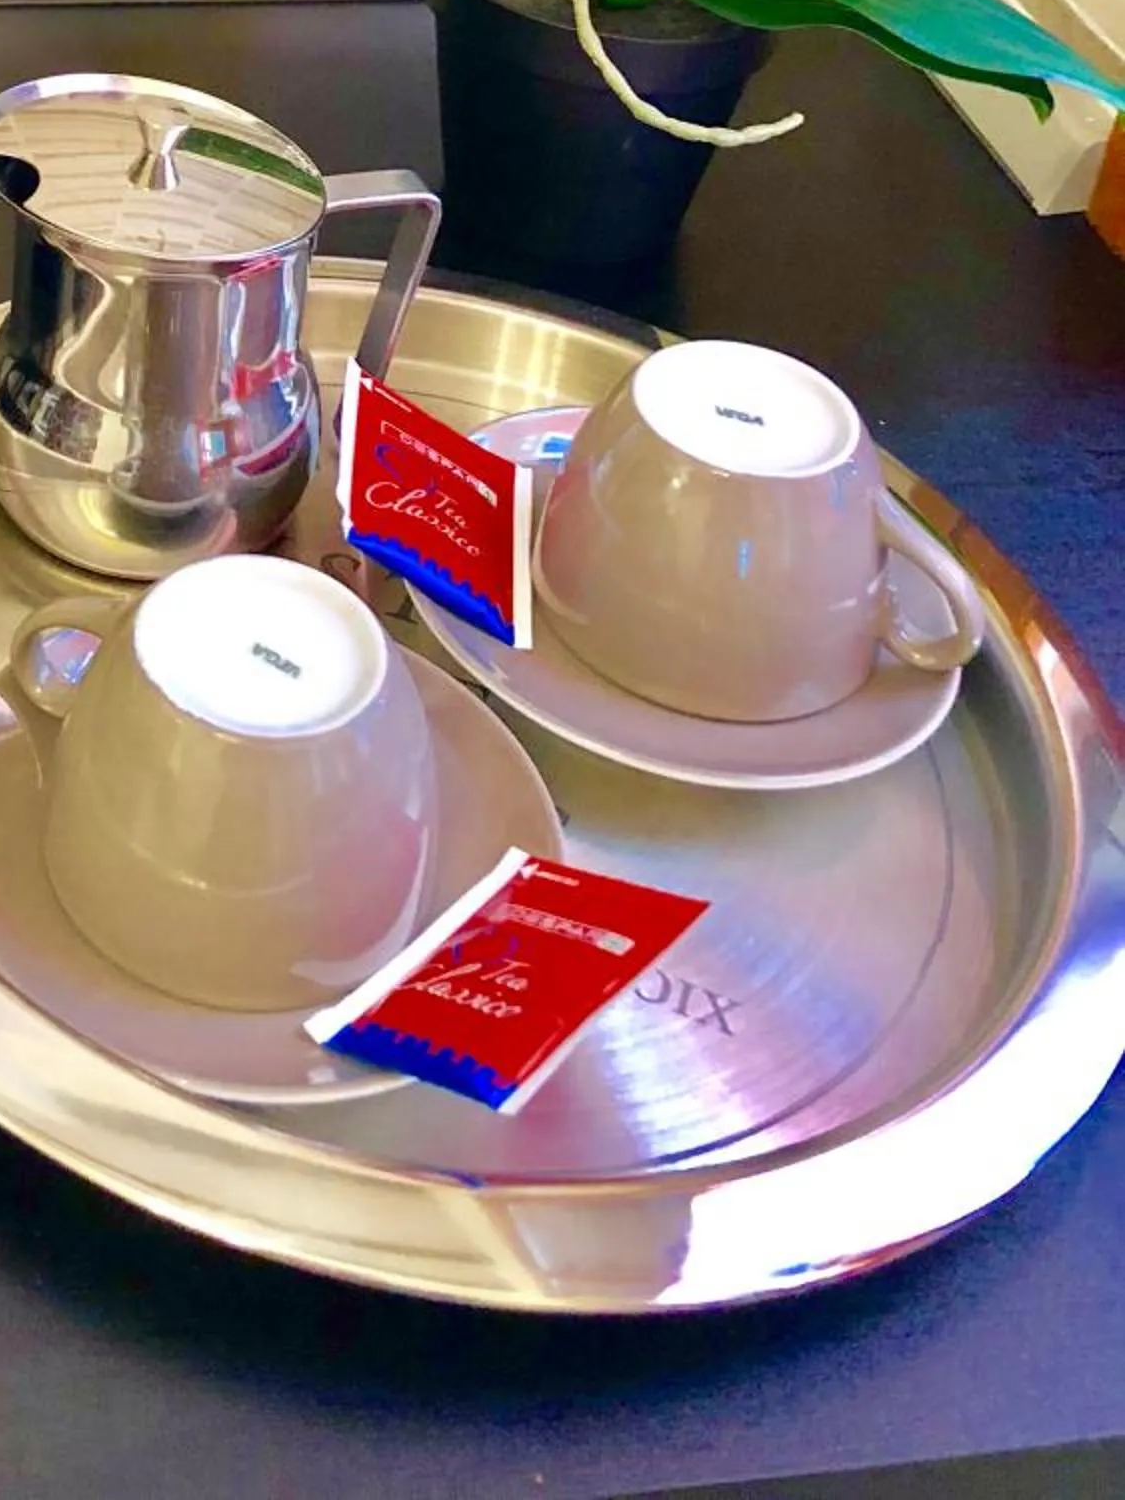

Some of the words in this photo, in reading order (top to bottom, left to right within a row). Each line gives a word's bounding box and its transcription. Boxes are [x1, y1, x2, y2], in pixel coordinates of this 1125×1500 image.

[364, 480, 481, 557] Classico
[434, 489, 470, 528] Tea
[480, 958, 531, 991] Tea
